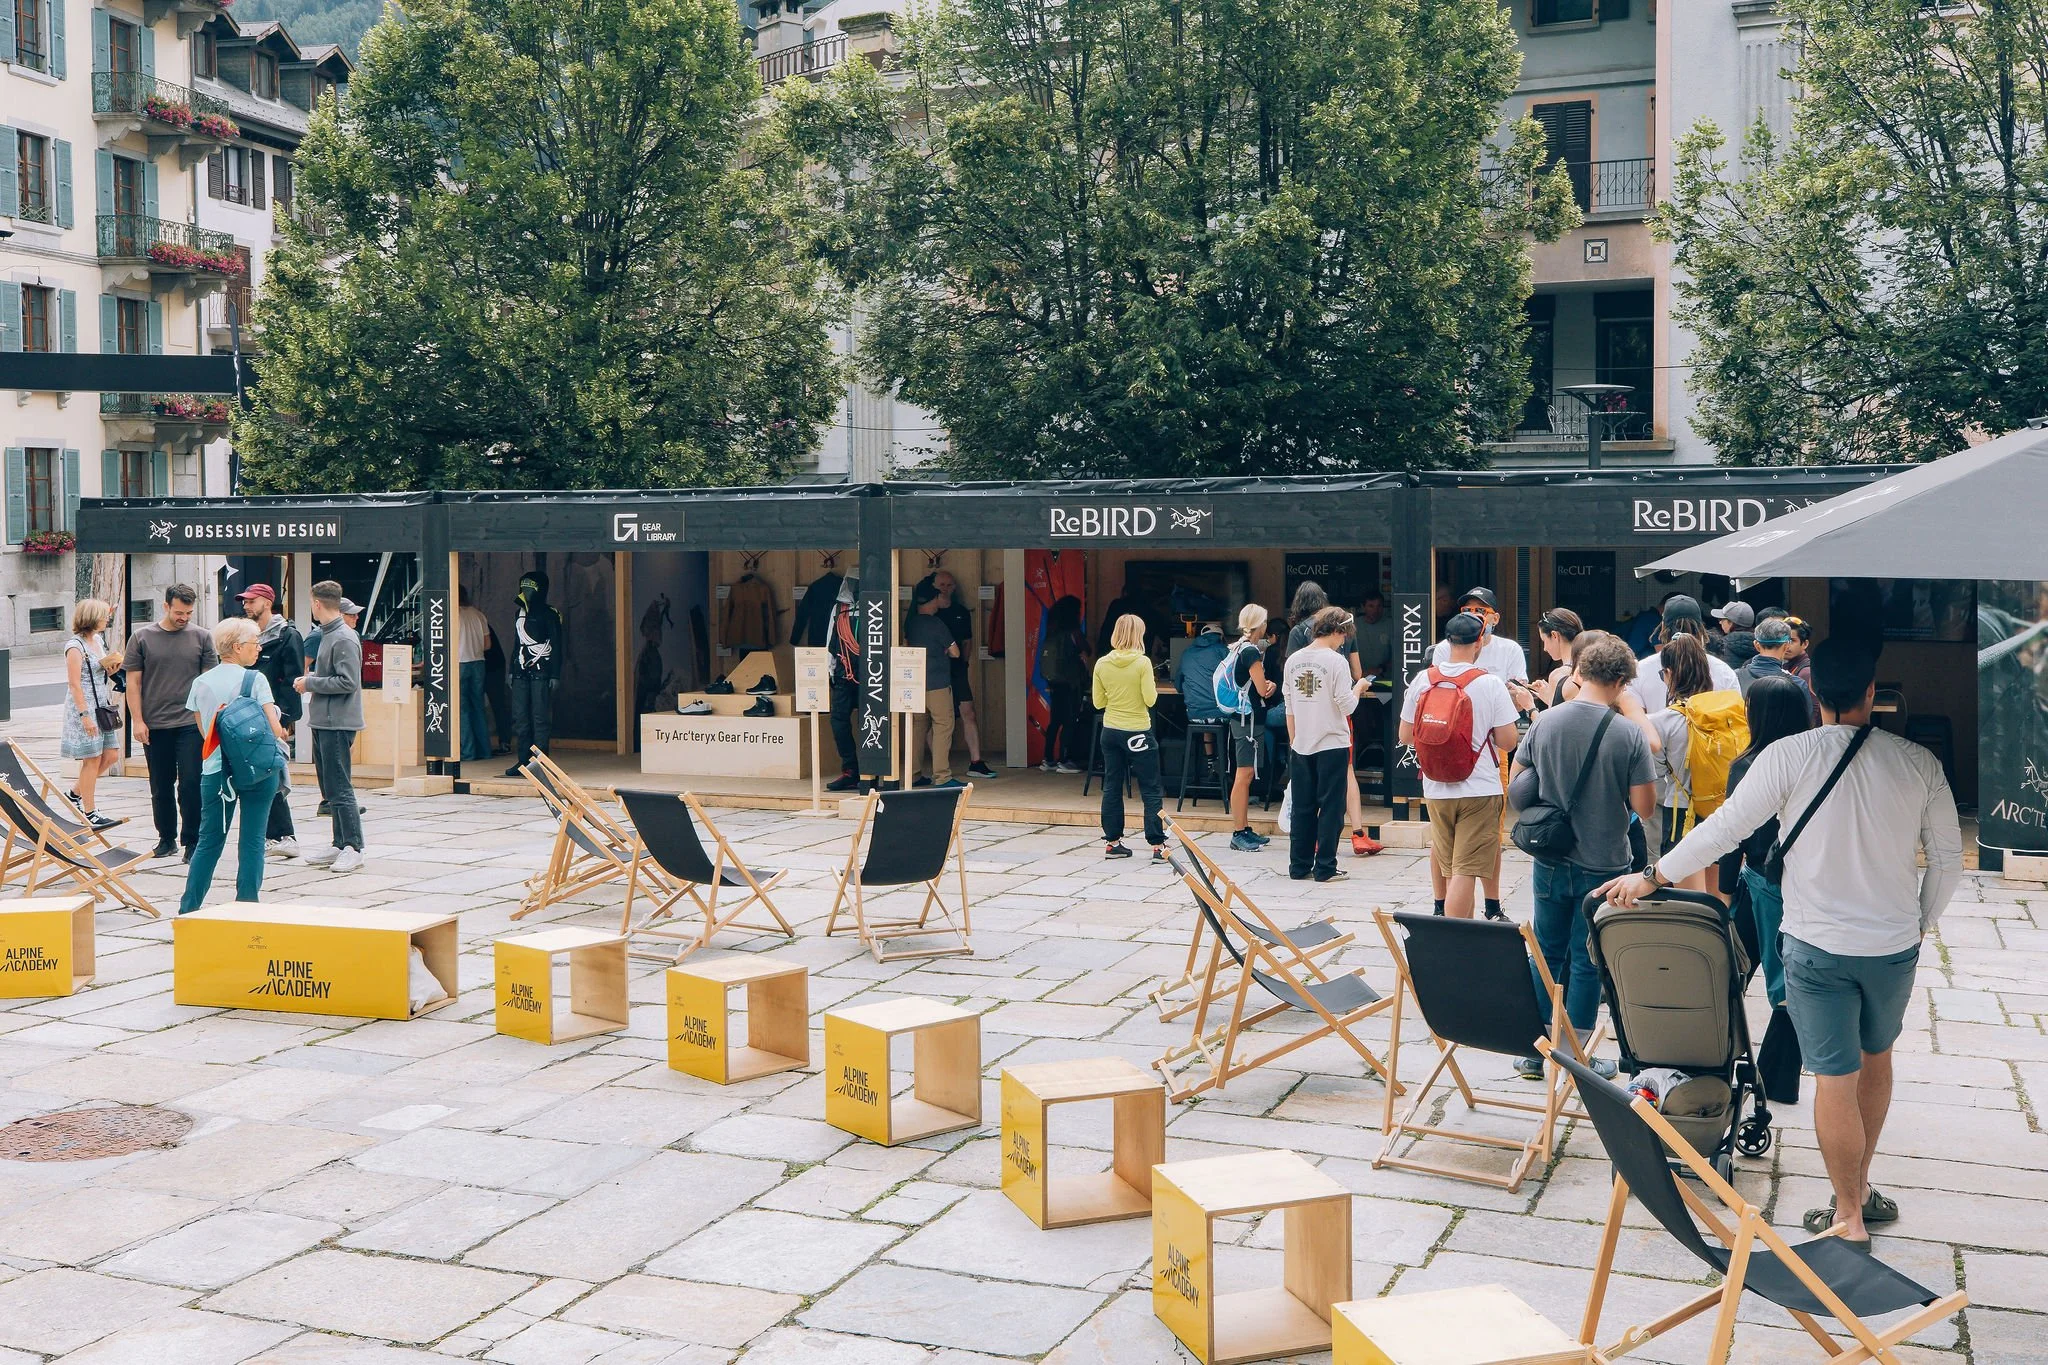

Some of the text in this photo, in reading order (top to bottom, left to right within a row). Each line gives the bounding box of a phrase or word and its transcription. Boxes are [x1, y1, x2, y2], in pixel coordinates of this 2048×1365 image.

[184, 522, 337, 539] OBSESSIVE DESIGN
[641, 523, 661, 531] GEAR
[646, 532, 677, 541] LIBRARY
[1287, 564, 1329, 575] ReCARE
[1557, 565, 1593, 576] ReCUT
[430, 598, 444, 691] ARC'TERYX
[866, 600, 883, 702] ARC'TERYX
[655, 729, 671, 744] Try
[718, 731, 741, 743] Gear
[743, 732, 759, 744] For
[761, 733, 784, 744] Free
[5, 947, 44, 960] ALPINE
[5, 959, 58, 972] ACADEMY
[266, 960, 313, 979] ALPINE
[265, 978, 331, 999] ACADEMY
[511, 983, 534, 999] ALPINE
[510, 996, 542, 1014] ACADEMY
[684, 1015, 708, 1033] ALPINE
[683, 1030, 716, 1050] ACADEMY
[843, 1065, 869, 1088] ALPINE
[842, 1081, 878, 1106] ACADEMY
